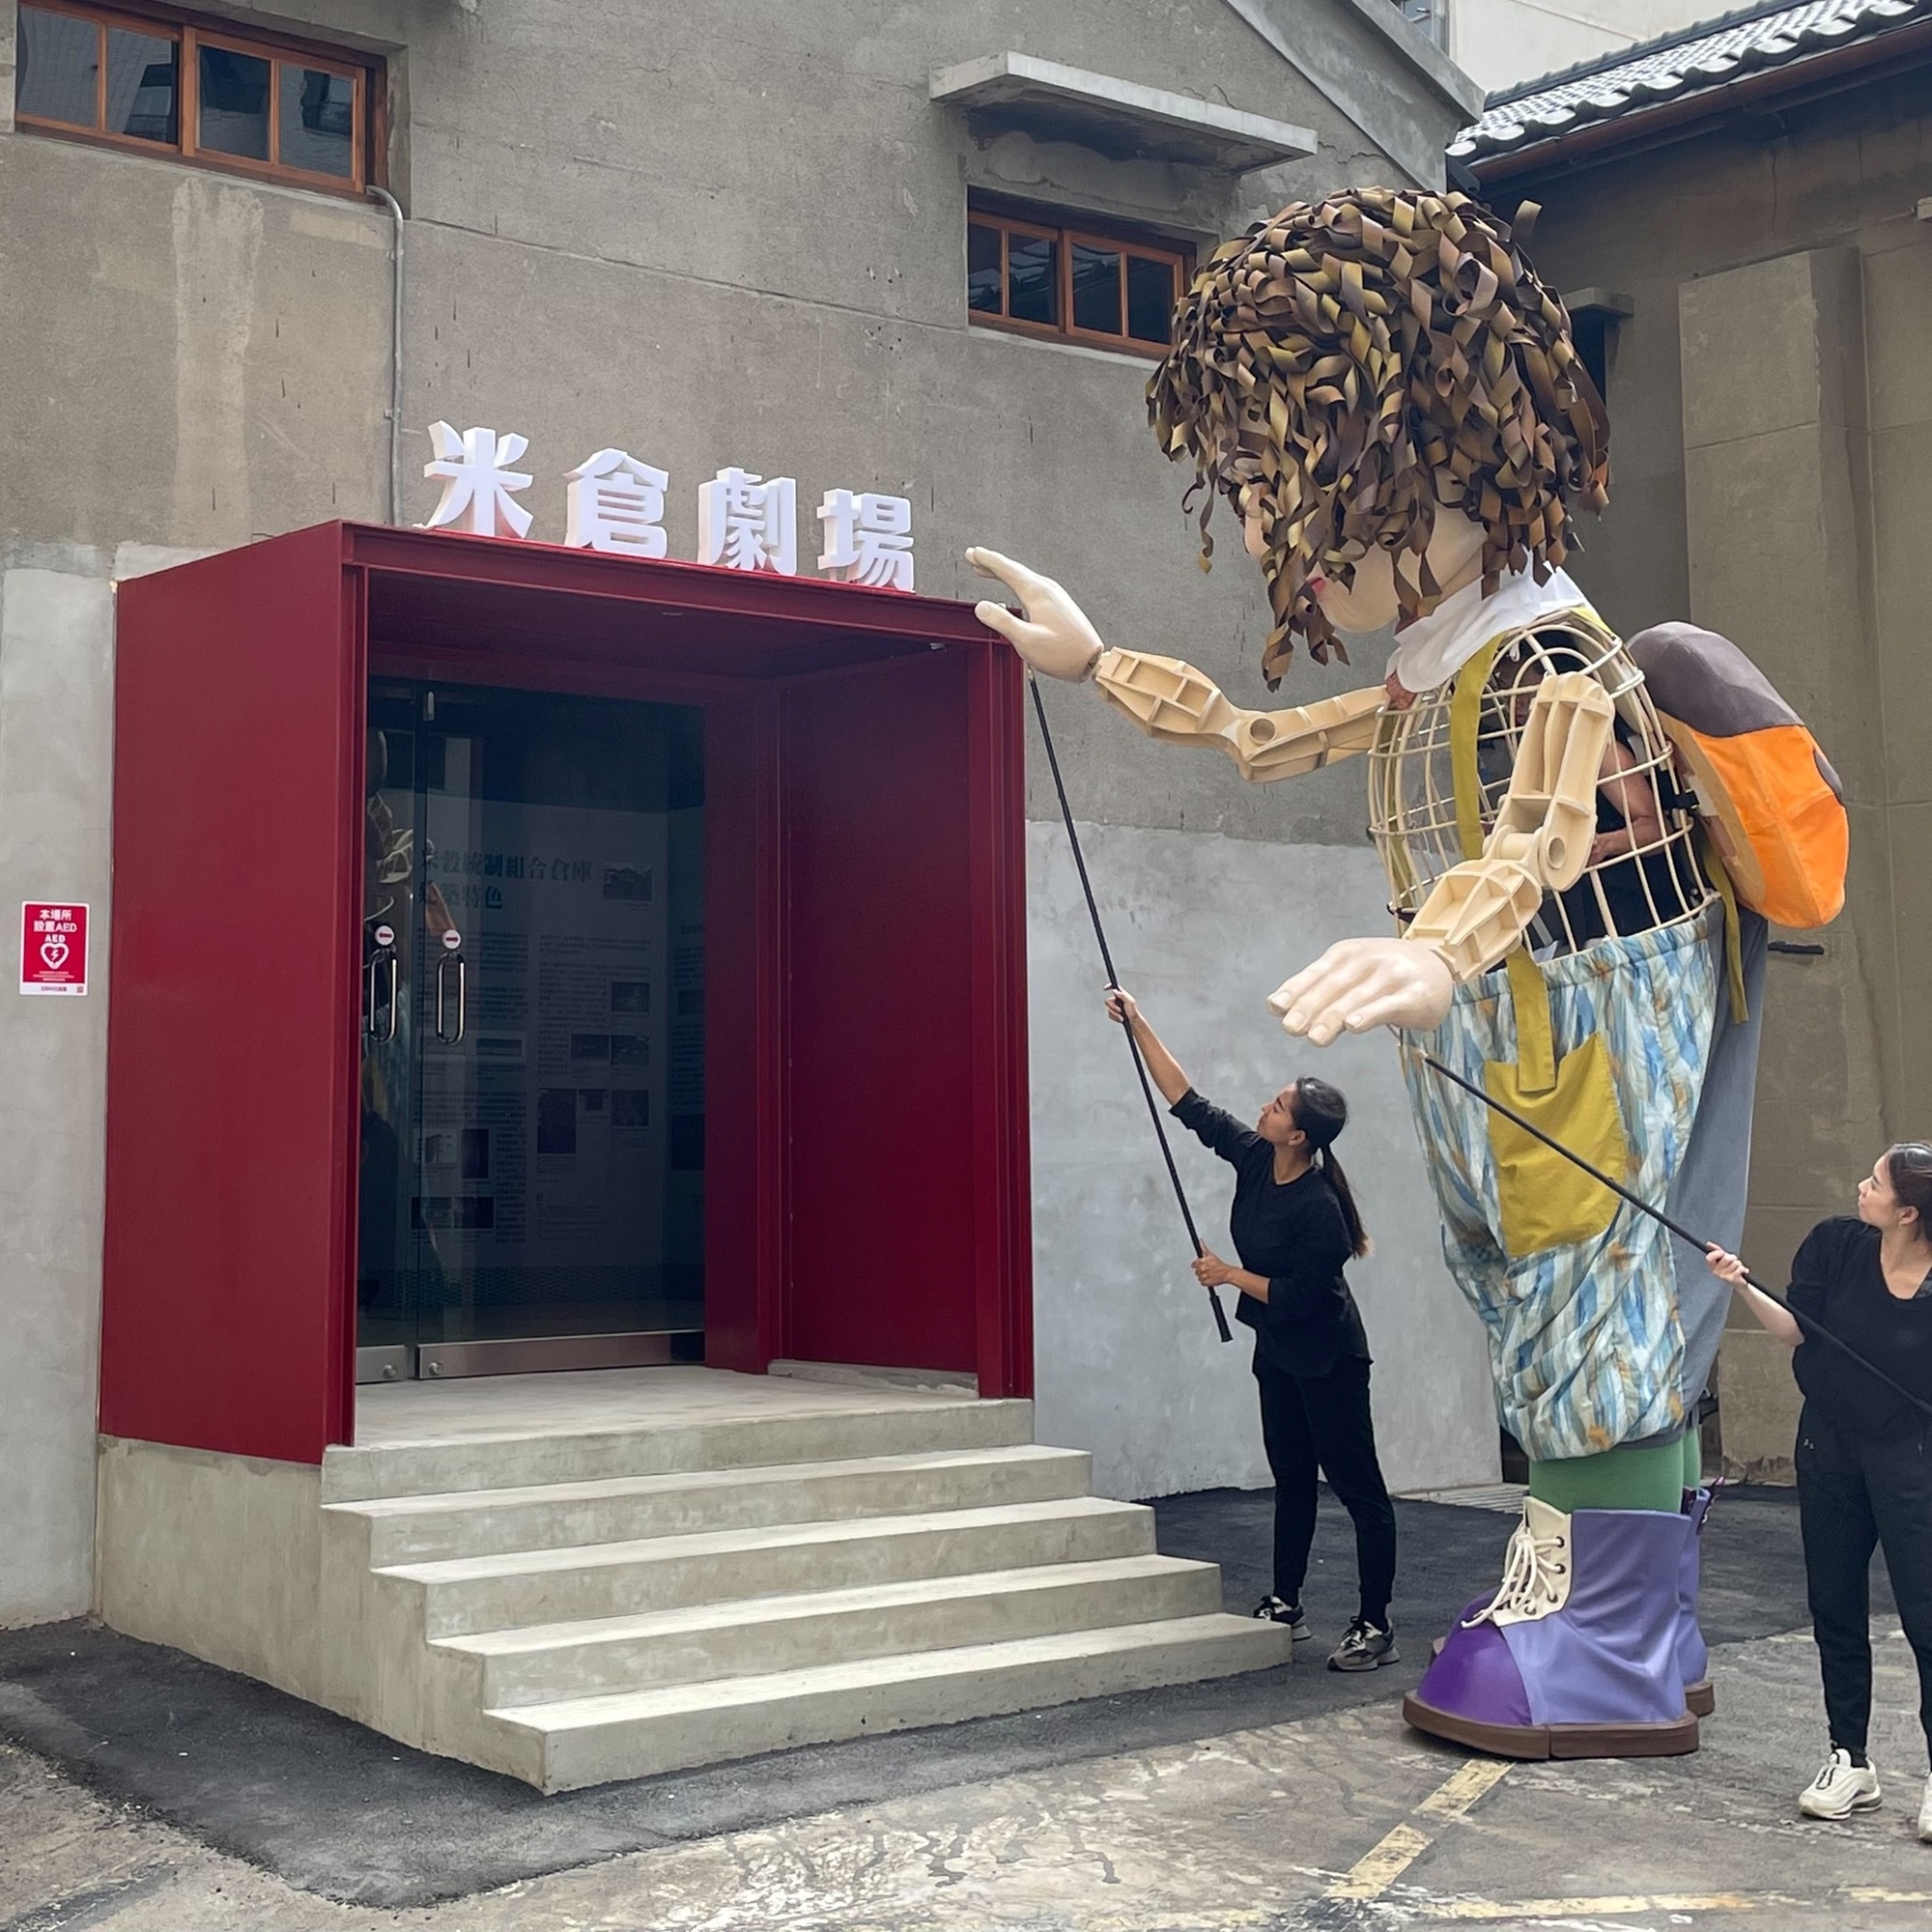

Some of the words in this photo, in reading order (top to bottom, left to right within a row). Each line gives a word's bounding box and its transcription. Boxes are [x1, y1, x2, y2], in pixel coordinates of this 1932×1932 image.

[422, 419, 916, 593] 米倉劇場
[40, 909, 72, 921] 本場所
[44, 933, 66, 943] AED
